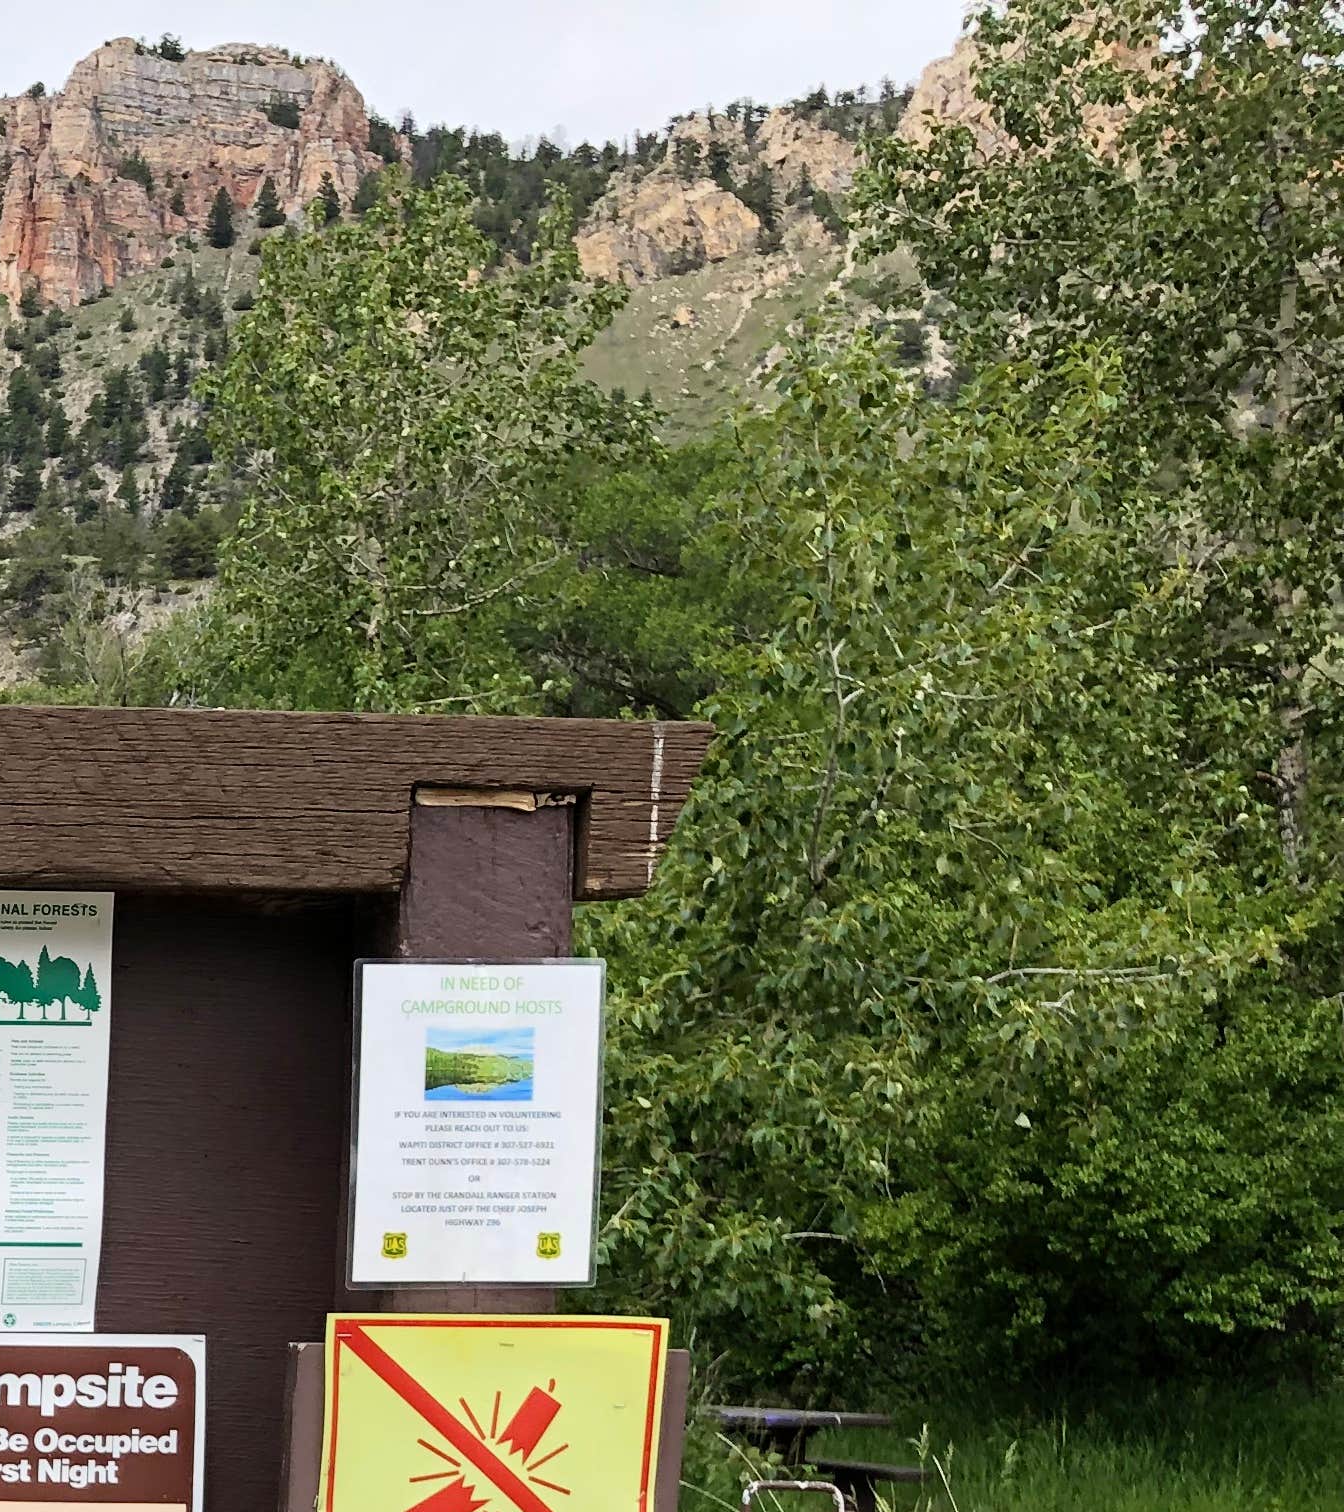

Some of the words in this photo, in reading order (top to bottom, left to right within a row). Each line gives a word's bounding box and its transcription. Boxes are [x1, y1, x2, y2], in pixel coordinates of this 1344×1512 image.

[32, 903, 98, 917] FORESTS
[440, 975, 456, 991] IN
[459, 976, 501, 992] NEED
[503, 976, 524, 991] OF
[401, 999, 511, 1015] CAMPGROUND
[515, 999, 562, 1015] HOSTS
[34, 1428, 177, 1458] Occupied
[38, 1459, 118, 1488] Night
